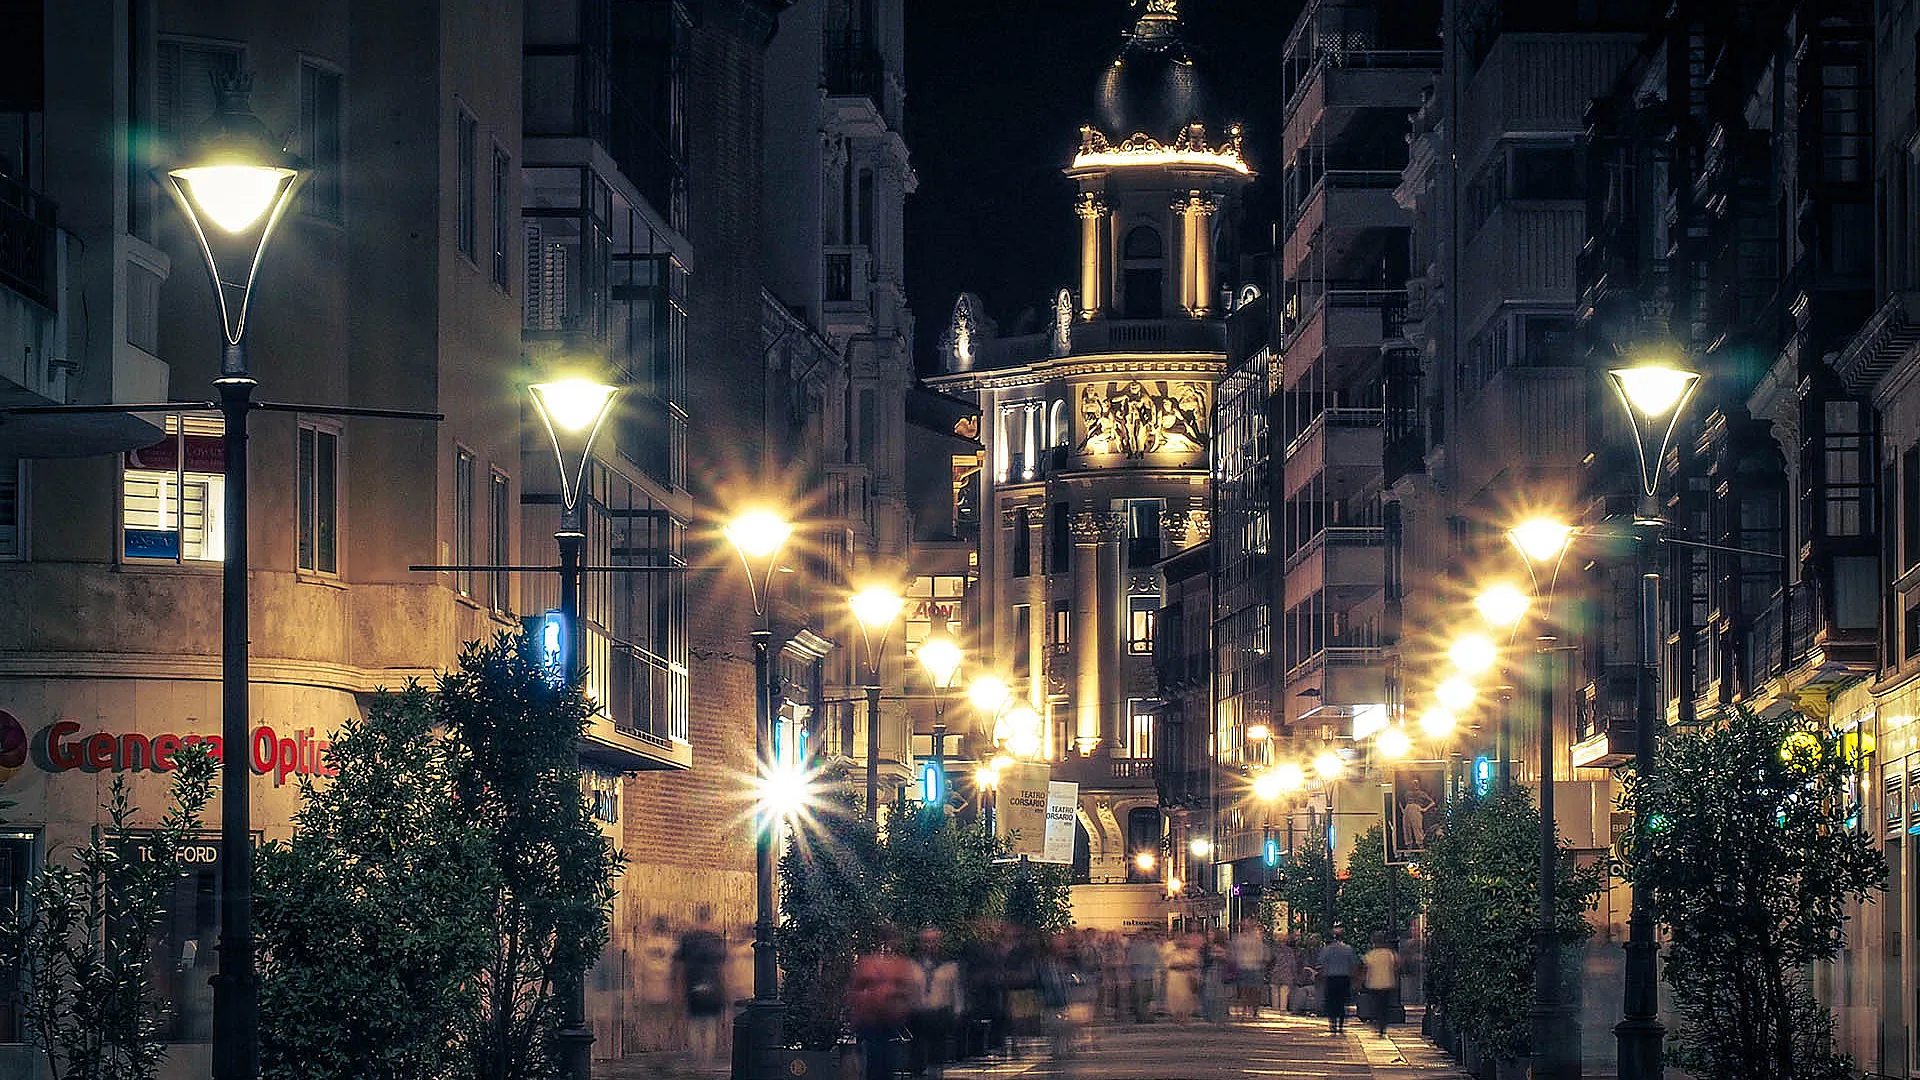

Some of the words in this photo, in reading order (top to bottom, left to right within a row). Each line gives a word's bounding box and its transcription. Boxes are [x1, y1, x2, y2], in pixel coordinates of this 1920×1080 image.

[48, 720, 224, 771] Genea
[1020, 790, 1046, 800] TEATRO
[1010, 797, 1046, 808] CORSARIO
[1051, 805, 1074, 814] TEATRO
[1046, 812, 1074, 821] ORSARIO
[138, 846, 163, 862] TO
[175, 846, 217, 862] FORD
